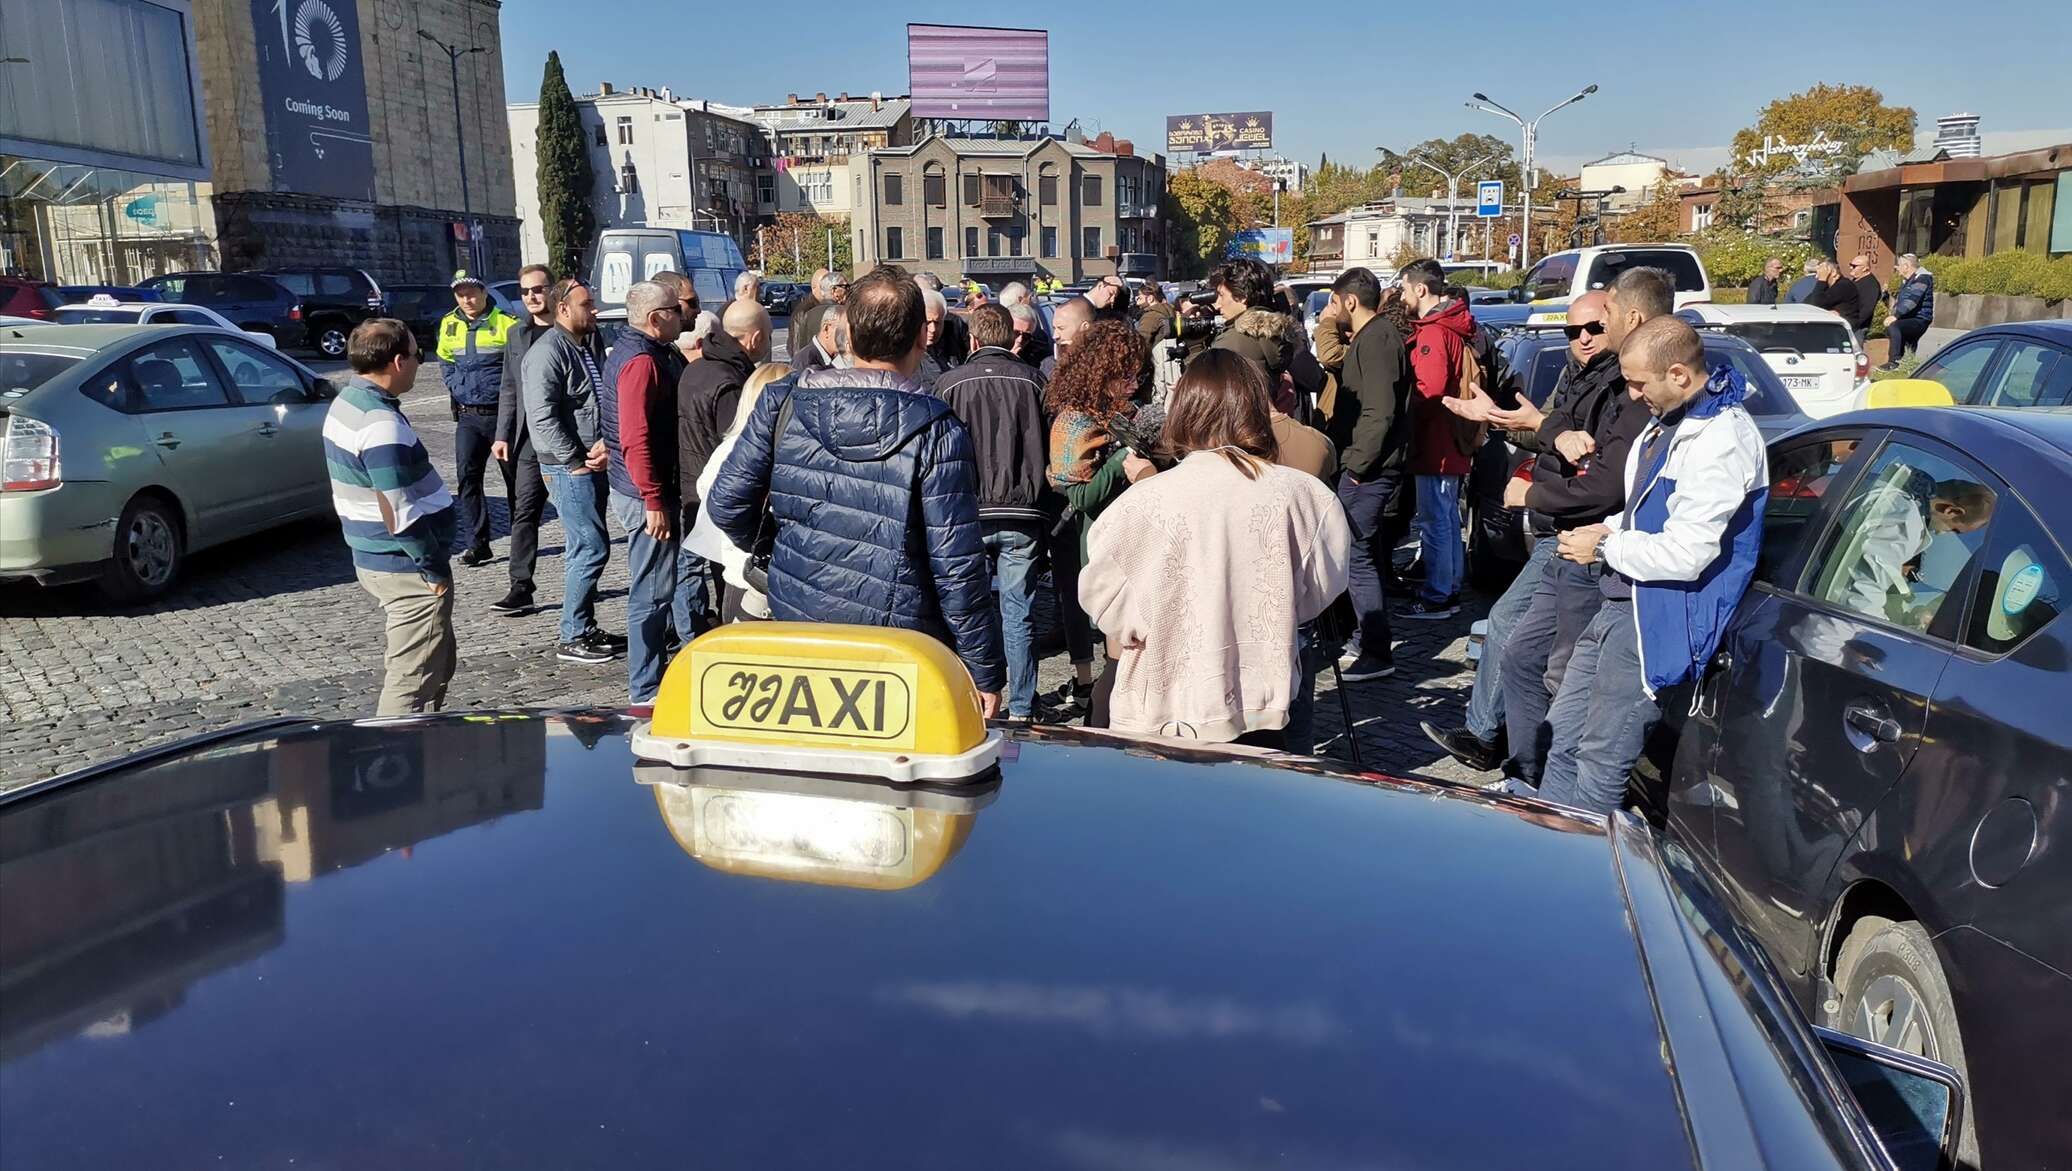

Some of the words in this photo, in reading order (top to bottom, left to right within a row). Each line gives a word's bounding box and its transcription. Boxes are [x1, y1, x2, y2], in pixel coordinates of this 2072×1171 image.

[285, 97, 324, 120] Coming
[325, 105, 350, 122] Soon
[1234, 133, 1270, 142] JEWEL
